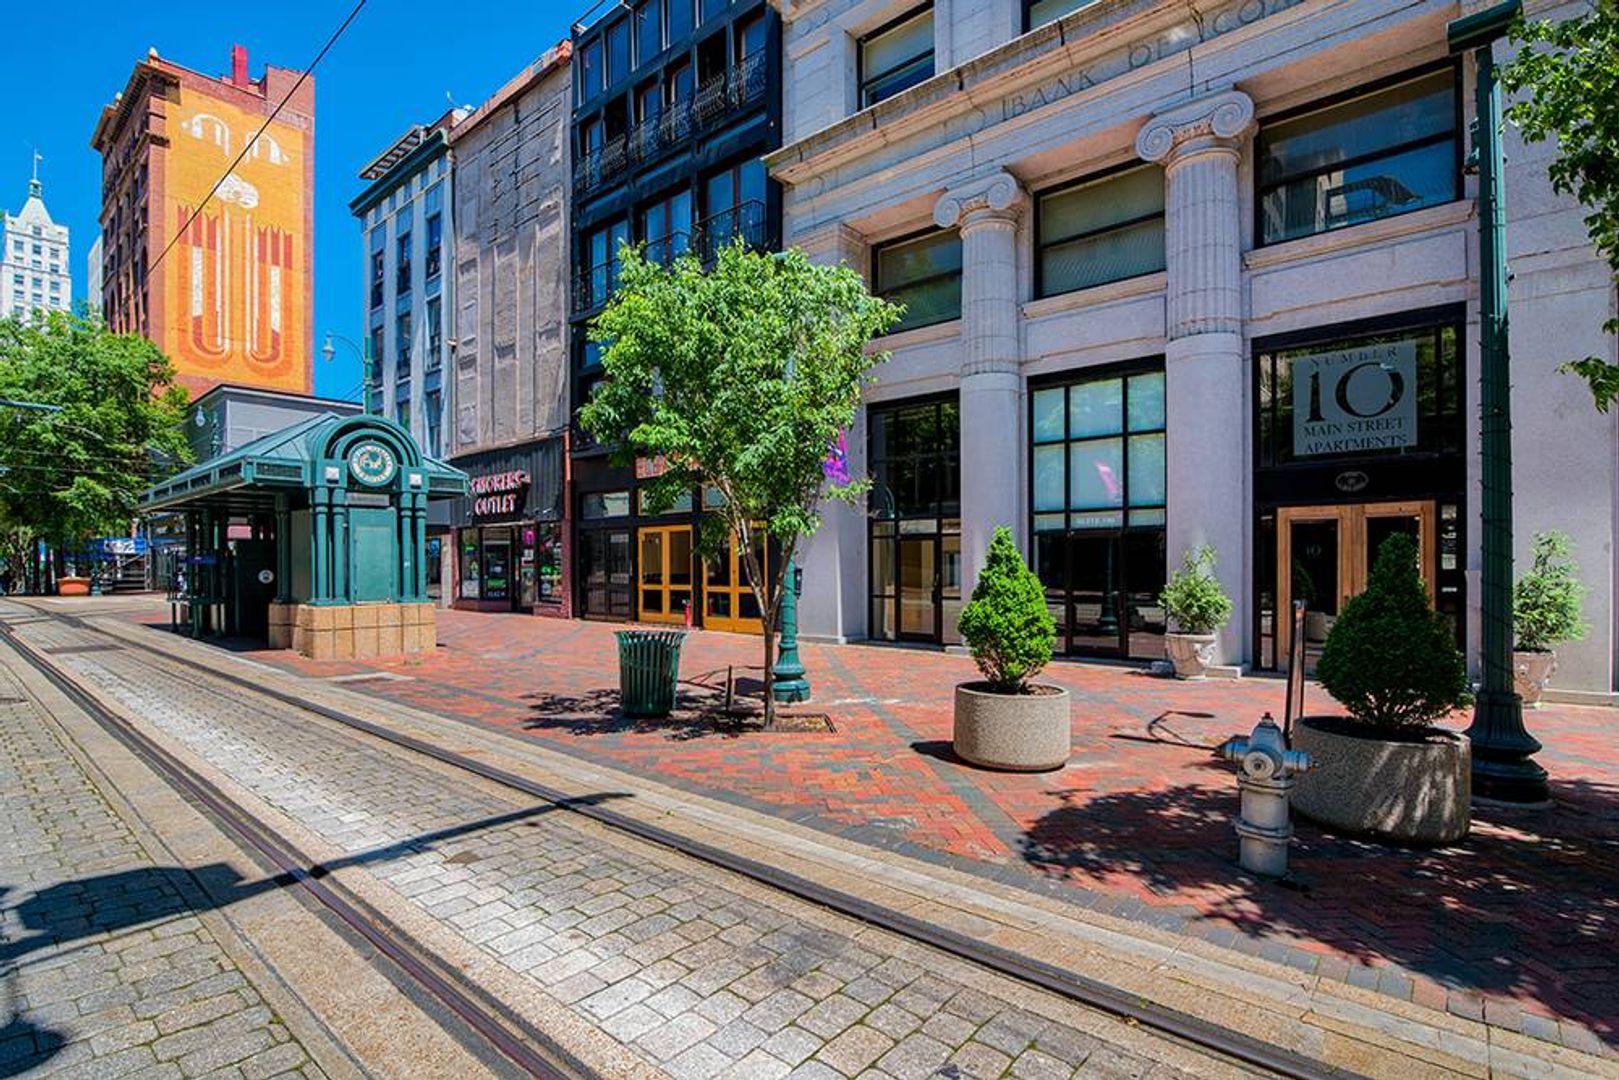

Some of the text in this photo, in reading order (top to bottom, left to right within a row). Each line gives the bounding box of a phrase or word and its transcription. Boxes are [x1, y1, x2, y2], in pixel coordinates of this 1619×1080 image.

[1011, 68, 1098, 116] BANK
[1310, 345, 1398, 367] NUMBER
[1305, 361, 1405, 423] 10
[1303, 417, 1405, 438] MAIN STREET
[1304, 434, 1408, 454] APARTMENTS
[474, 493, 517, 516] OUTLET
